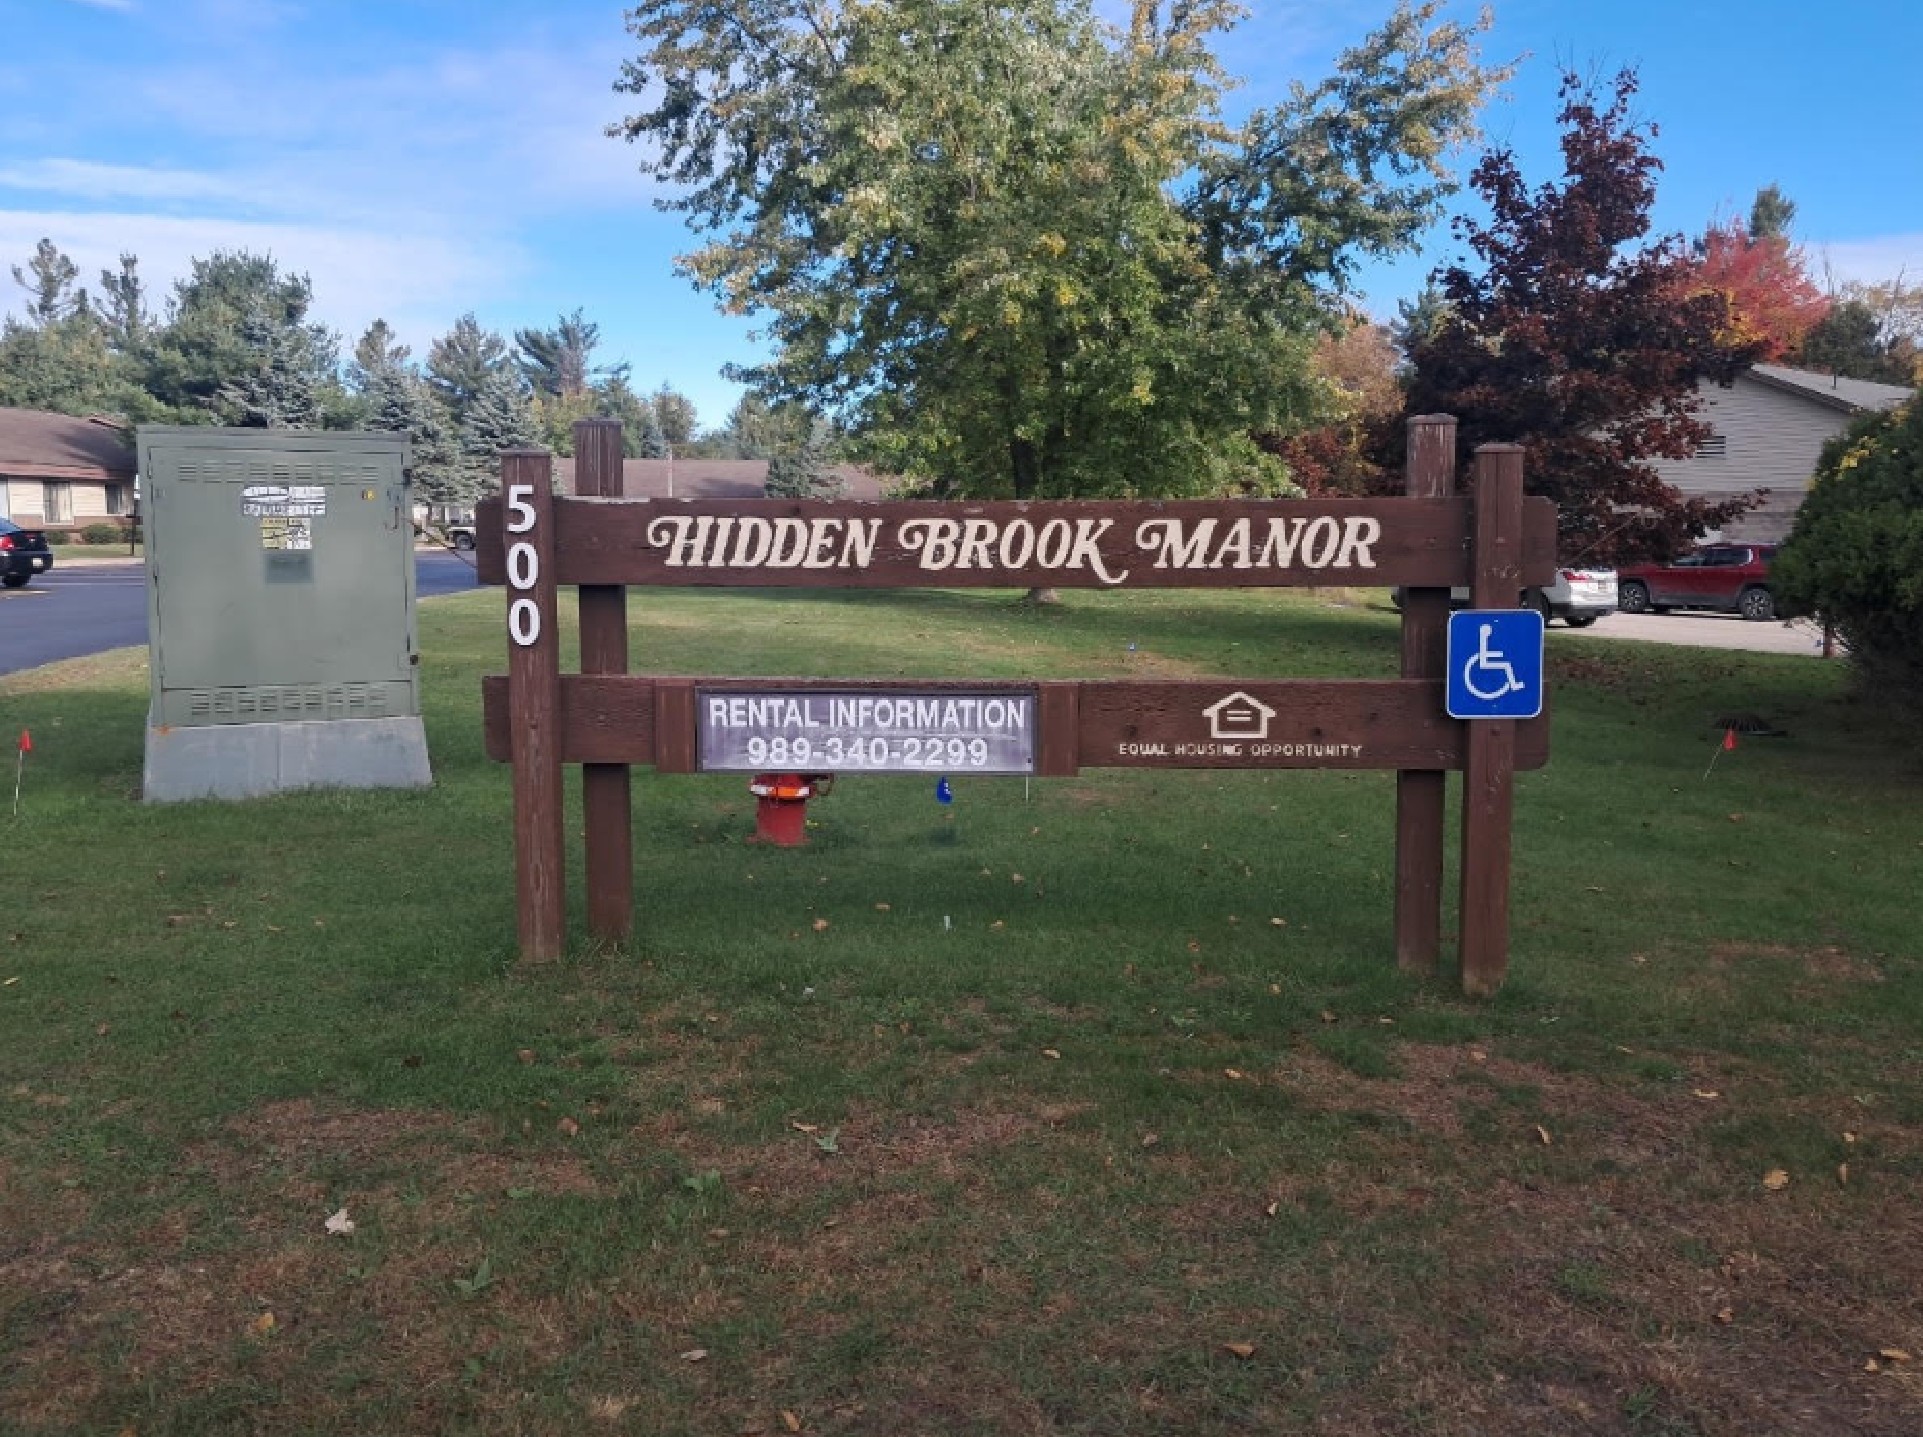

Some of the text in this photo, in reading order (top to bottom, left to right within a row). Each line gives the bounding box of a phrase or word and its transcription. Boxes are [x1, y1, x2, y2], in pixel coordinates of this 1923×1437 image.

[507, 484, 541, 646] 500
[647, 515, 1381, 584] HIDDEN BROOK MANOR
[708, 698, 1025, 729] RENTAL INFORMATION
[747, 737, 988, 766] 989-340-2299
[1118, 743, 1363, 758] EQUAL HOUSING OPPORTUNITY
